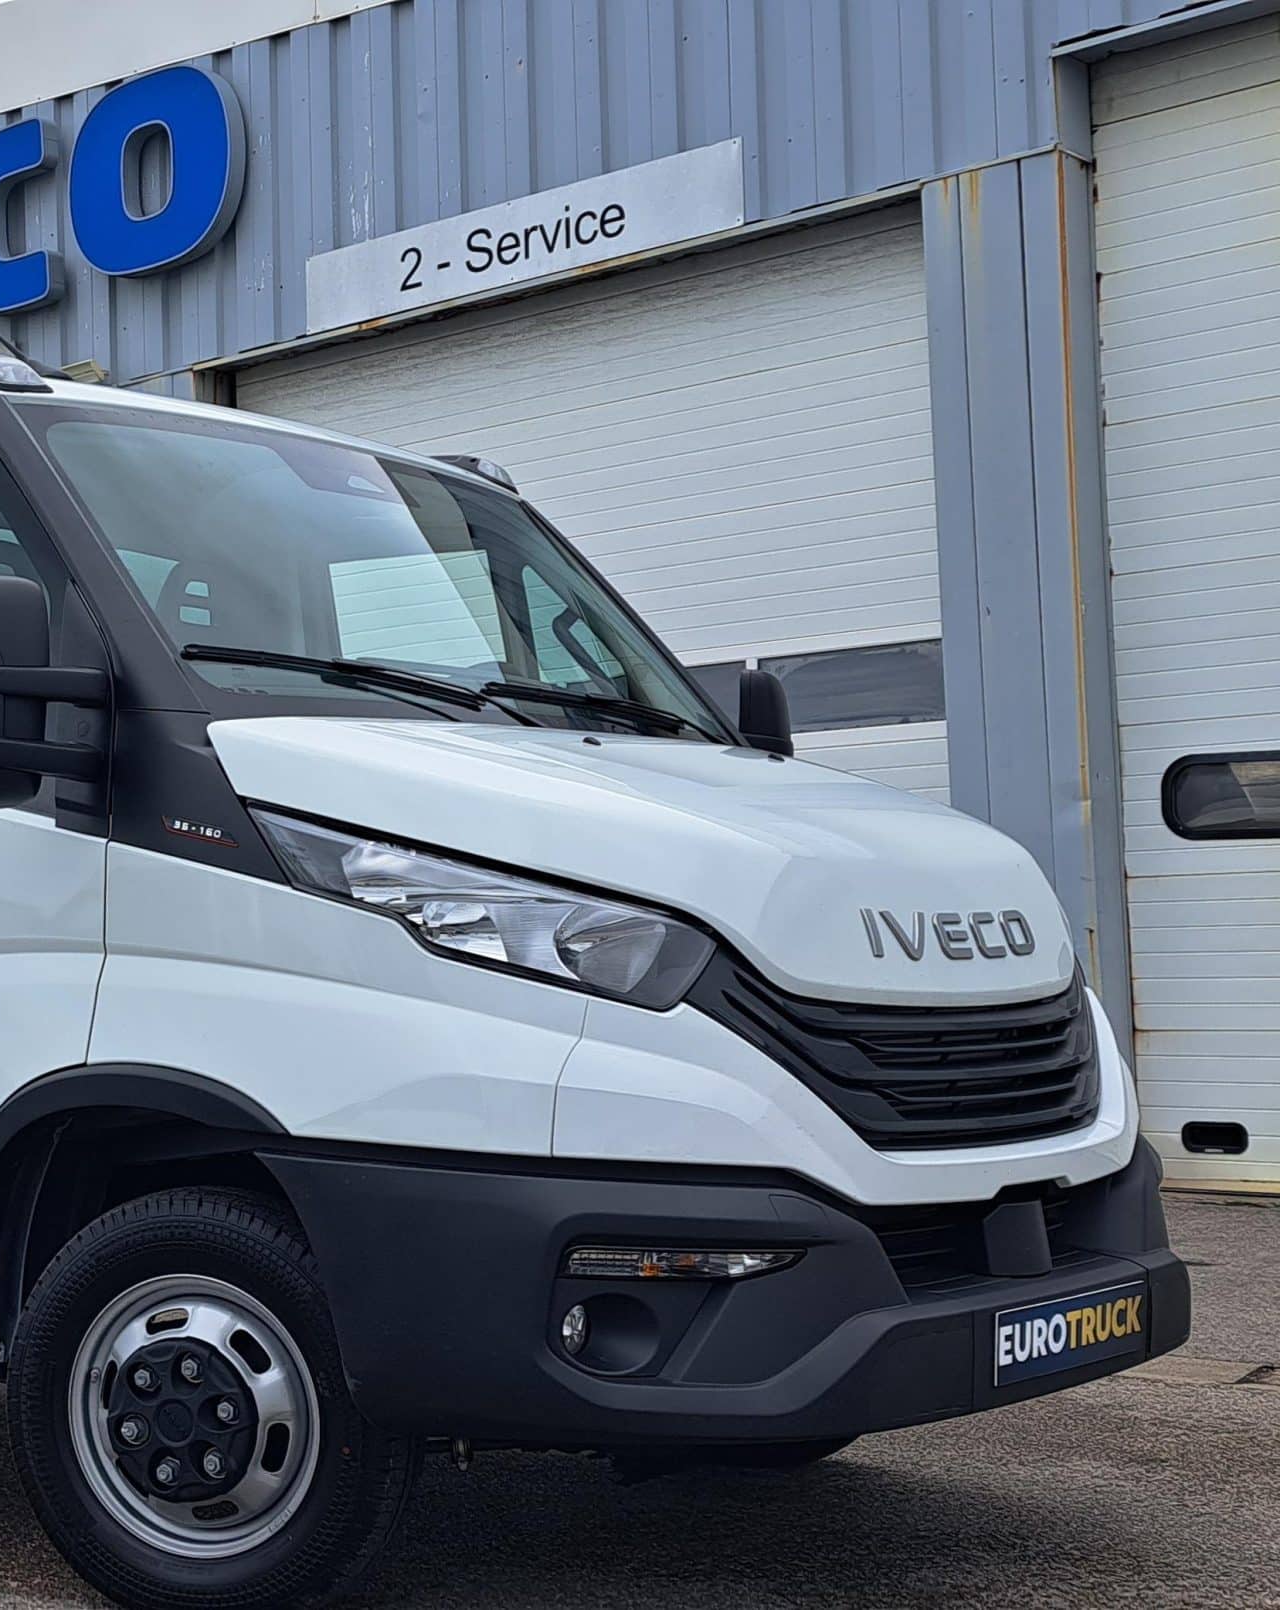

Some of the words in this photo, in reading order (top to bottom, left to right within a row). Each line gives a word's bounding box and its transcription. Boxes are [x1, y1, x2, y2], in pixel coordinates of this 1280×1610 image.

[399, 247, 422, 292] 2
[465, 203, 626, 272] Service
[860, 908, 1035, 960] IVECO
[998, 1295, 1143, 1367] EUROTRUCK
